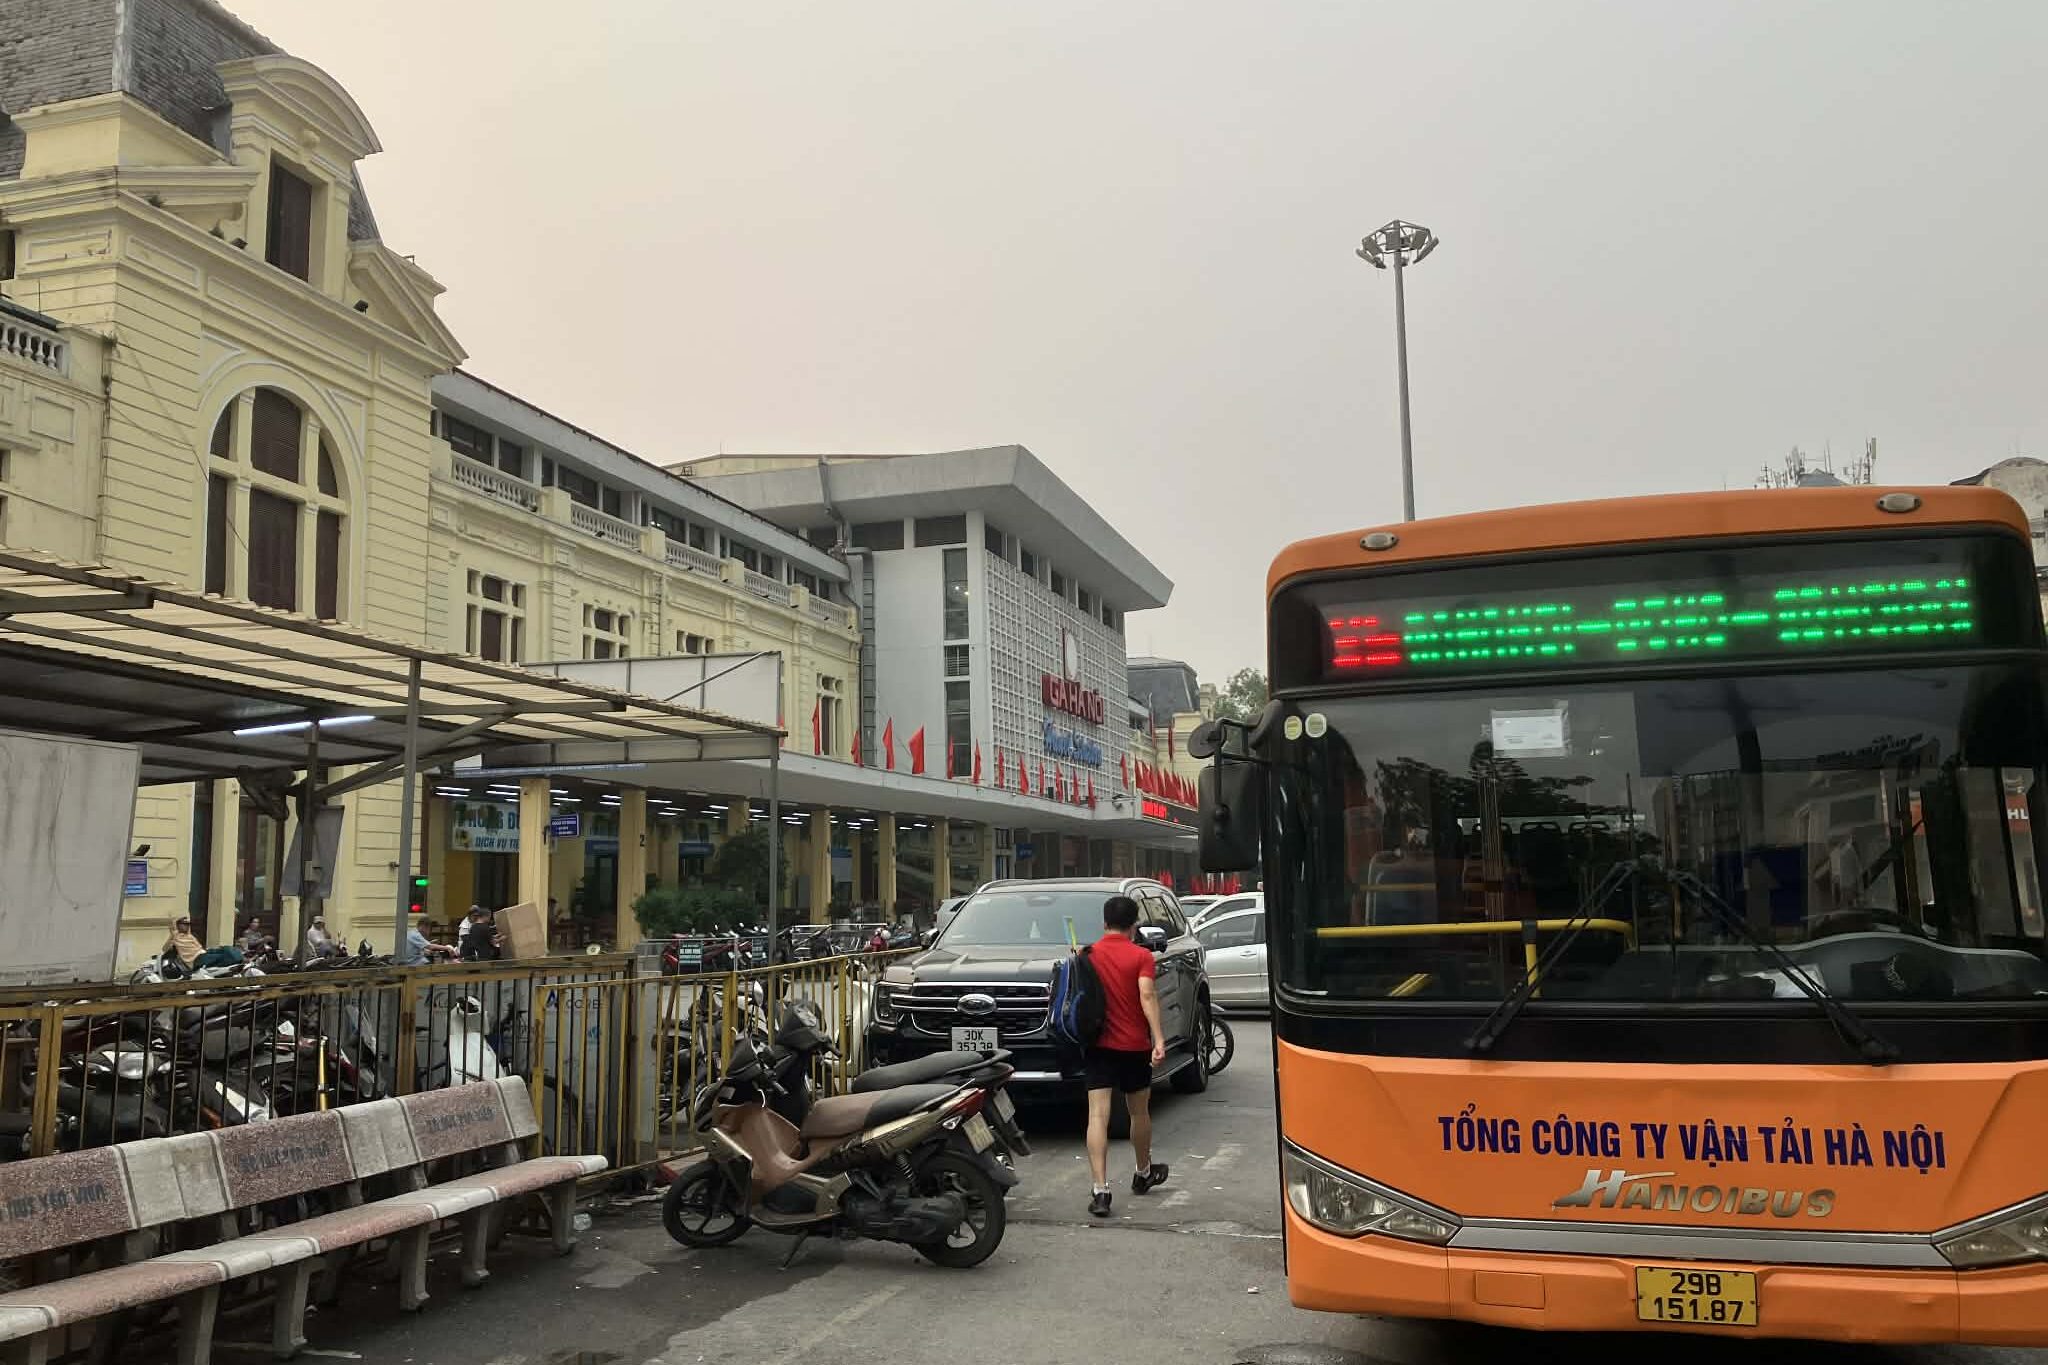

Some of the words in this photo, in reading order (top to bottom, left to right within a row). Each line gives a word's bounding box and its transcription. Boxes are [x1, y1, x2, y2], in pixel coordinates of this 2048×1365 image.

[639, 834, 646, 847] 2
[1438, 1103, 1521, 1154] TỔNG
[1531, 1113, 1621, 1158] CÔNG
[1631, 1123, 1668, 1160] TY
[1678, 1118, 1749, 1168] VẬN
[1758, 1116, 1814, 1165] TẢI
[1824, 1122, 1873, 1167] HÀ
[1883, 1123, 1946, 1175] NỘI
[1669, 1271, 1722, 1296] 29B
[1653, 1296, 1744, 1323] 151.87
